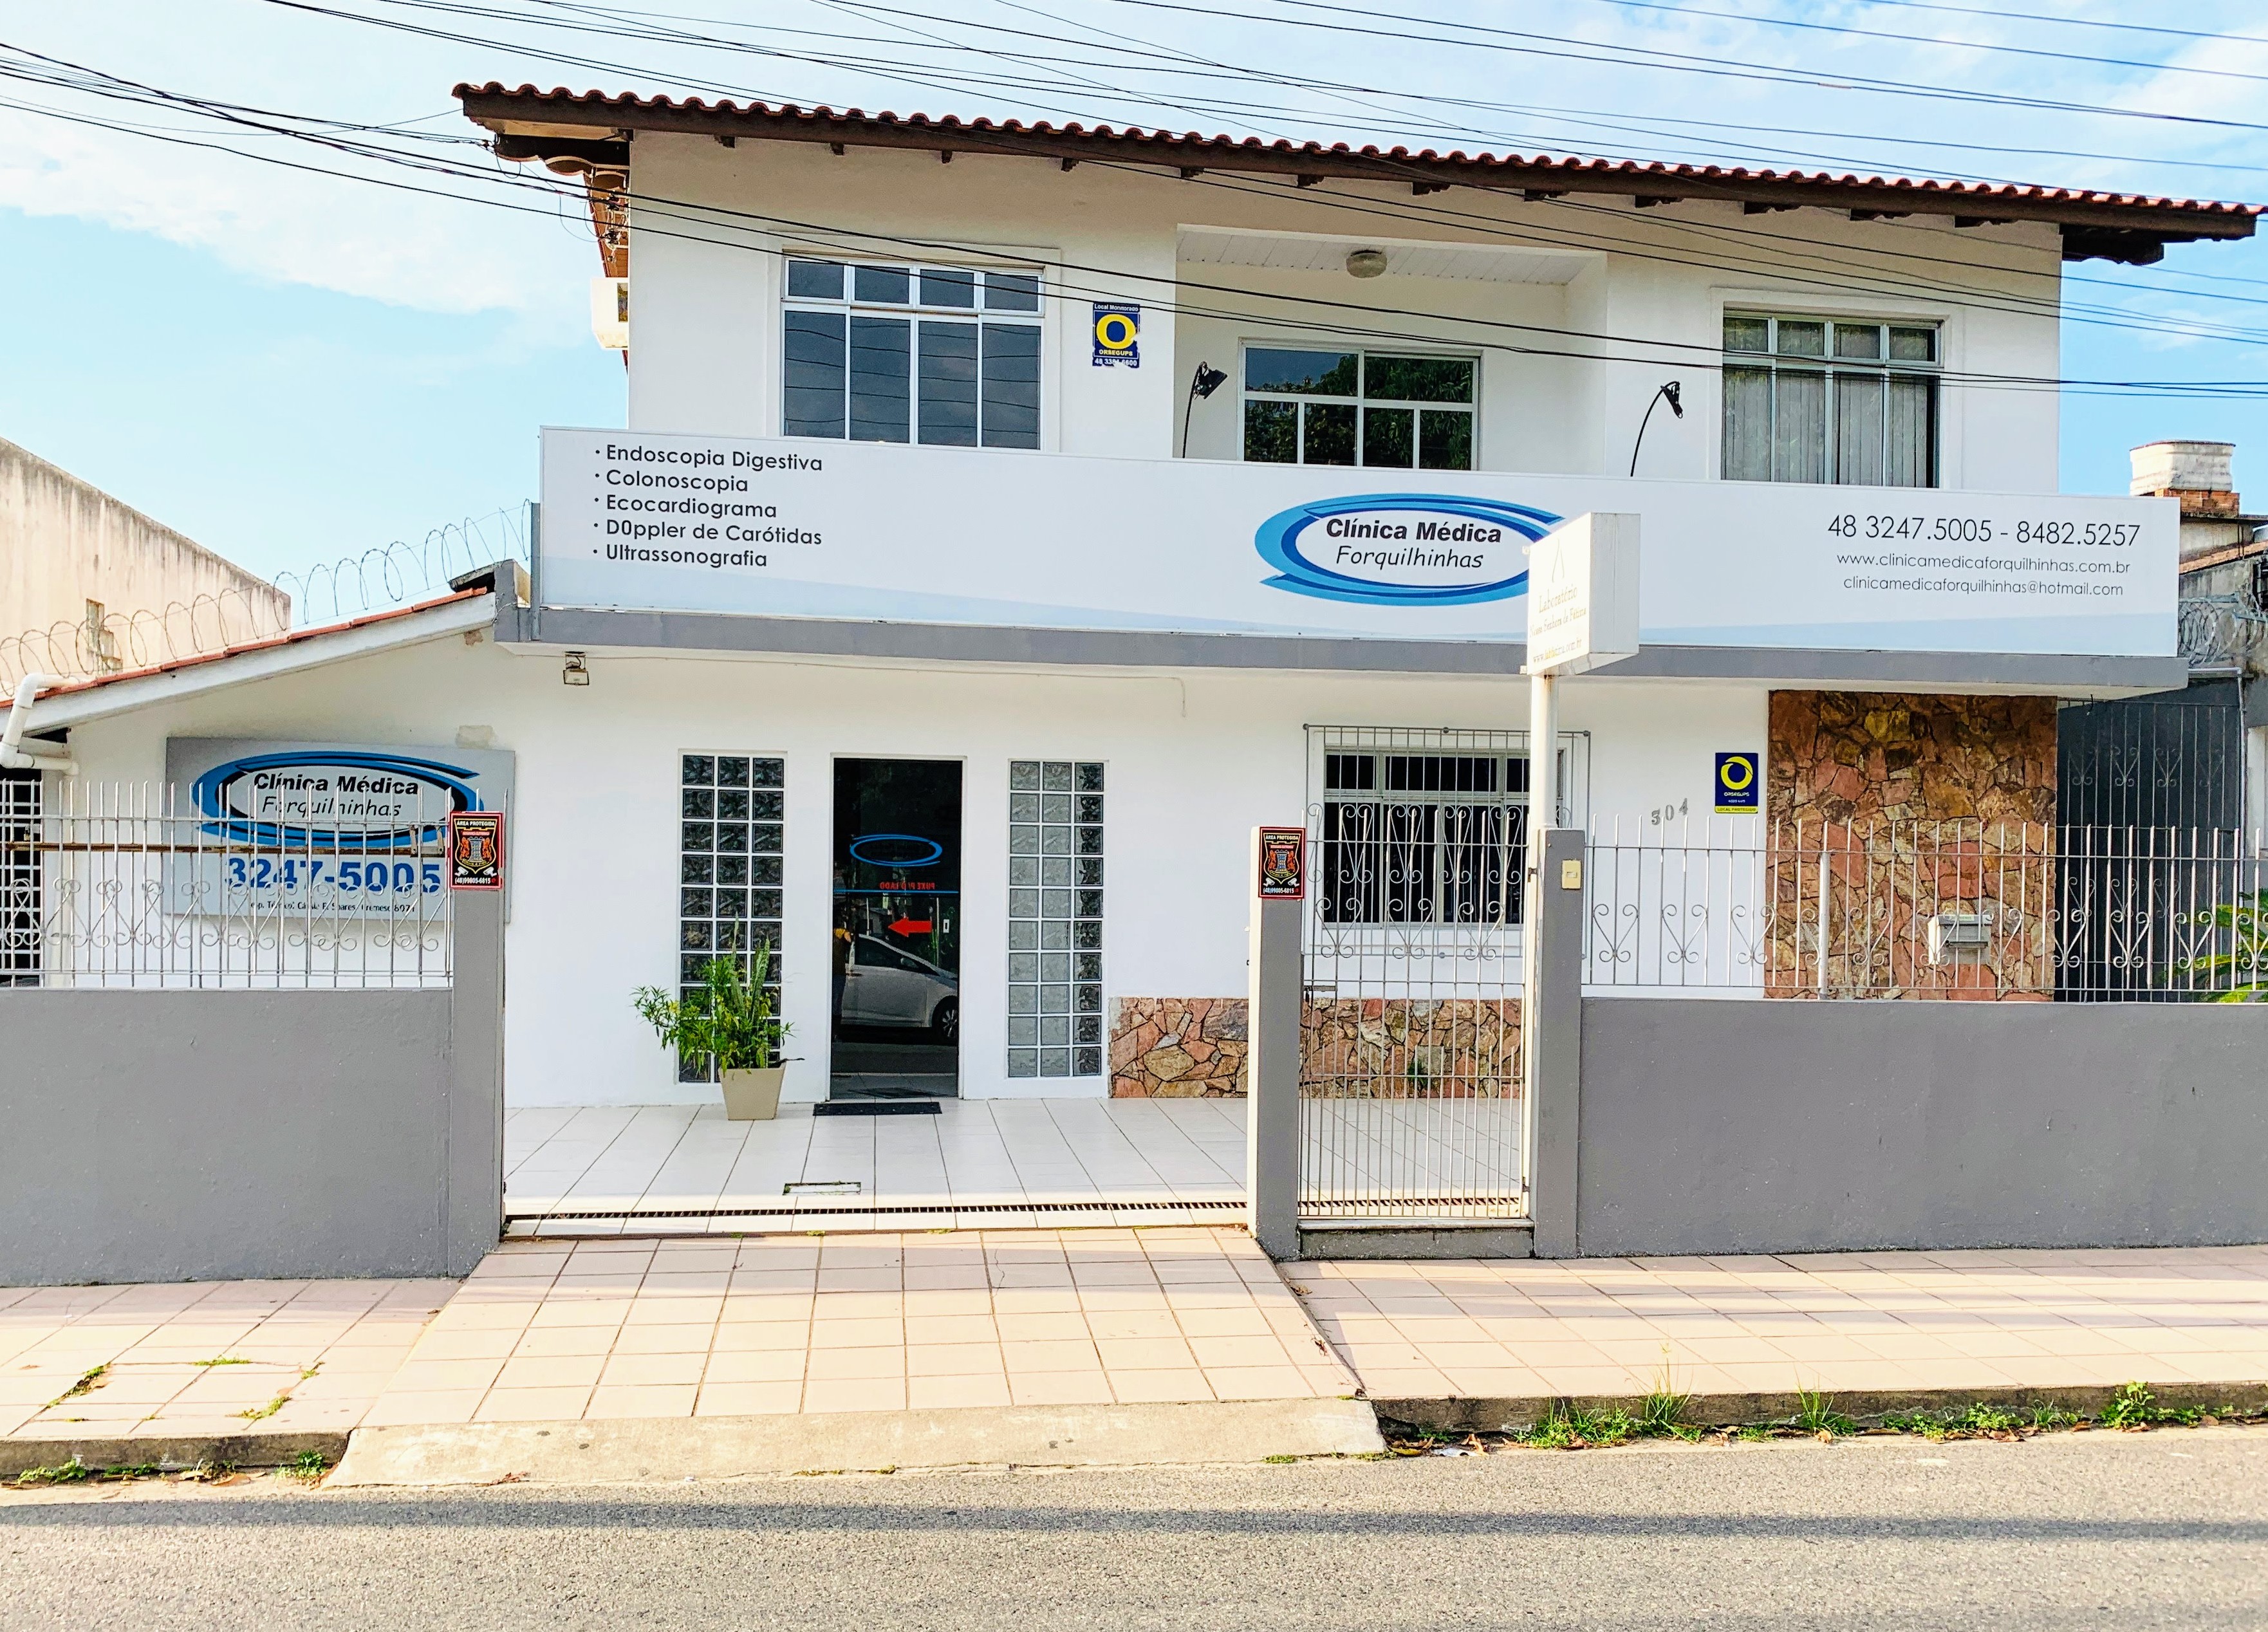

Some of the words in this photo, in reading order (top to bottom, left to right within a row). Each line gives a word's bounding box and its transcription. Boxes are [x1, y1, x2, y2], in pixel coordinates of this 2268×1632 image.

[608, 445, 724, 468] Endoscopia
[732, 452, 822, 472] Digestiva
[607, 470, 748, 494] Colonoscopia
[608, 495, 776, 519] Ecocardiograma
[693, 523, 719, 539] de
[726, 525, 822, 545] Carótidas
[1326, 518, 1408, 540] Clínica
[1416, 521, 1501, 542] Médica
[1828, 515, 1857, 537] 48
[1865, 515, 1992, 542] 3247.5005
[2016, 521, 2141, 546] 8482.5257
[607, 544, 767, 568] Ultrassonografia
[1336, 545, 1483, 571] Forquilhinhas
[1837, 553, 2131, 573] www.clinicamedicaforquilhinhas.com.br
[1843, 575, 2123, 595] clinicamedicaforquilhinhas@hotmail.com
[254, 772, 328, 791] Clínica
[337, 775, 419, 795] Médica
[225, 858, 441, 893] 3247-5005
